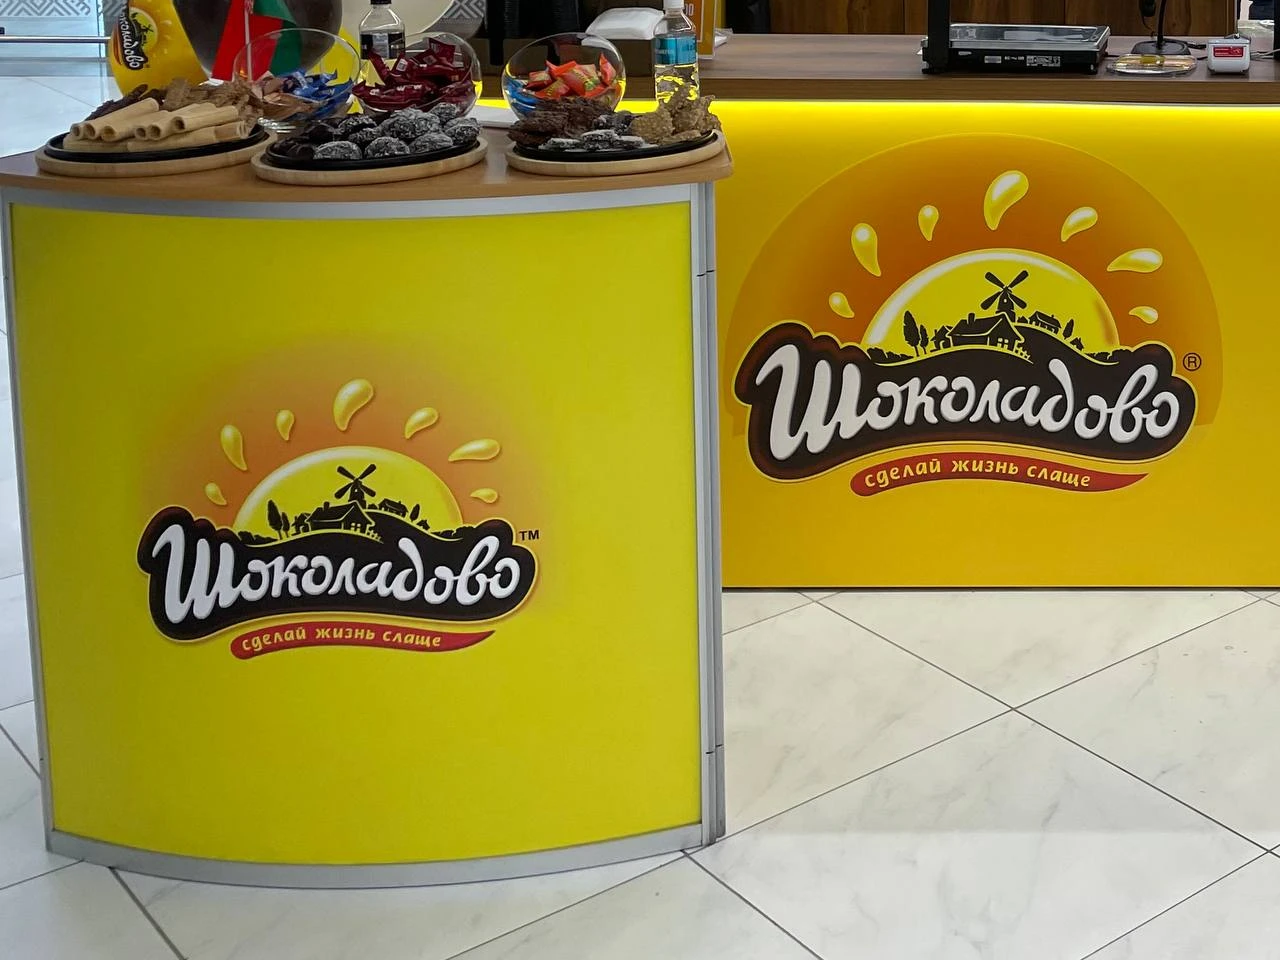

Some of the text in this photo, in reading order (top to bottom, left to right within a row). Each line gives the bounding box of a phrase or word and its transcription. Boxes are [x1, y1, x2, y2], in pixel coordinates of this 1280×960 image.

[120, 0, 146, 68] околадово
[756, 344, 1180, 460] Шоколадово
[864, 458, 1092, 489] сделай жизнь слаще
[152, 524, 521, 624] Шоколадово
[242, 626, 442, 653] сделай жизнь слаще
